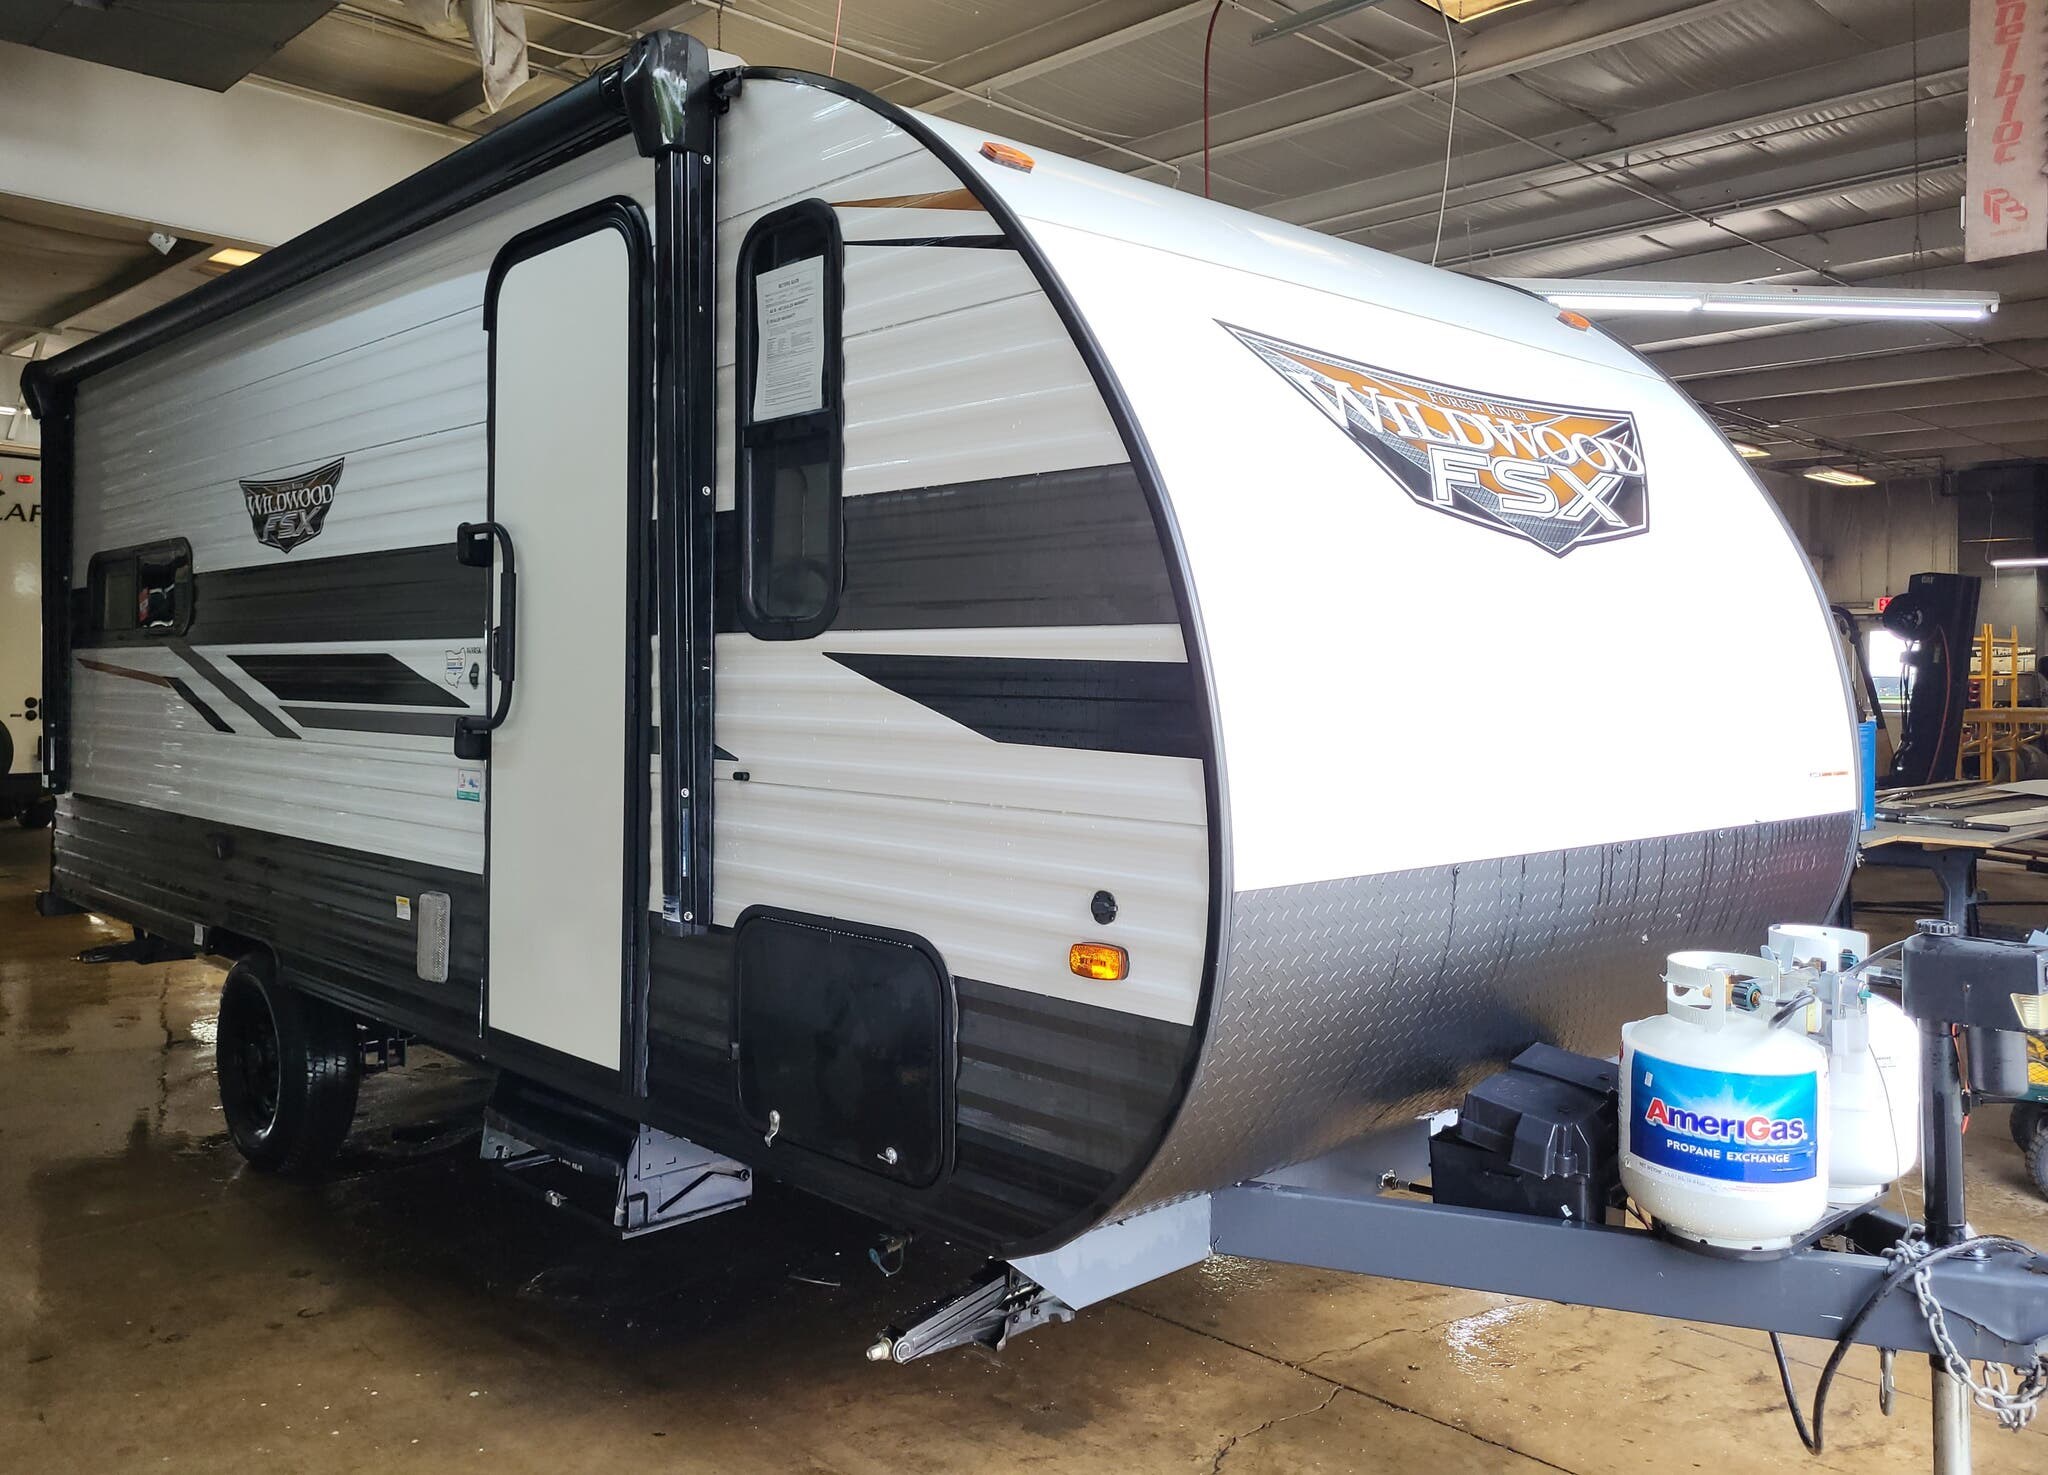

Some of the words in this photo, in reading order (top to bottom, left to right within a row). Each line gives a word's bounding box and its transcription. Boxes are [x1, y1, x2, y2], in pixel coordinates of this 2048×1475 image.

[1285, 370, 1646, 476] WILDWOOD
[1425, 391, 1484, 413] FOREST
[1484, 402, 1531, 421] RIVER
[247, 484, 334, 517] WILDWOOD
[1427, 444, 1629, 528] FSX
[262, 506, 321, 542] FSX
[1645, 1098, 1805, 1144] AmeriGas
[1666, 1138, 1721, 1159] PROPANE
[1726, 1151, 1790, 1164] EXCHANGE
